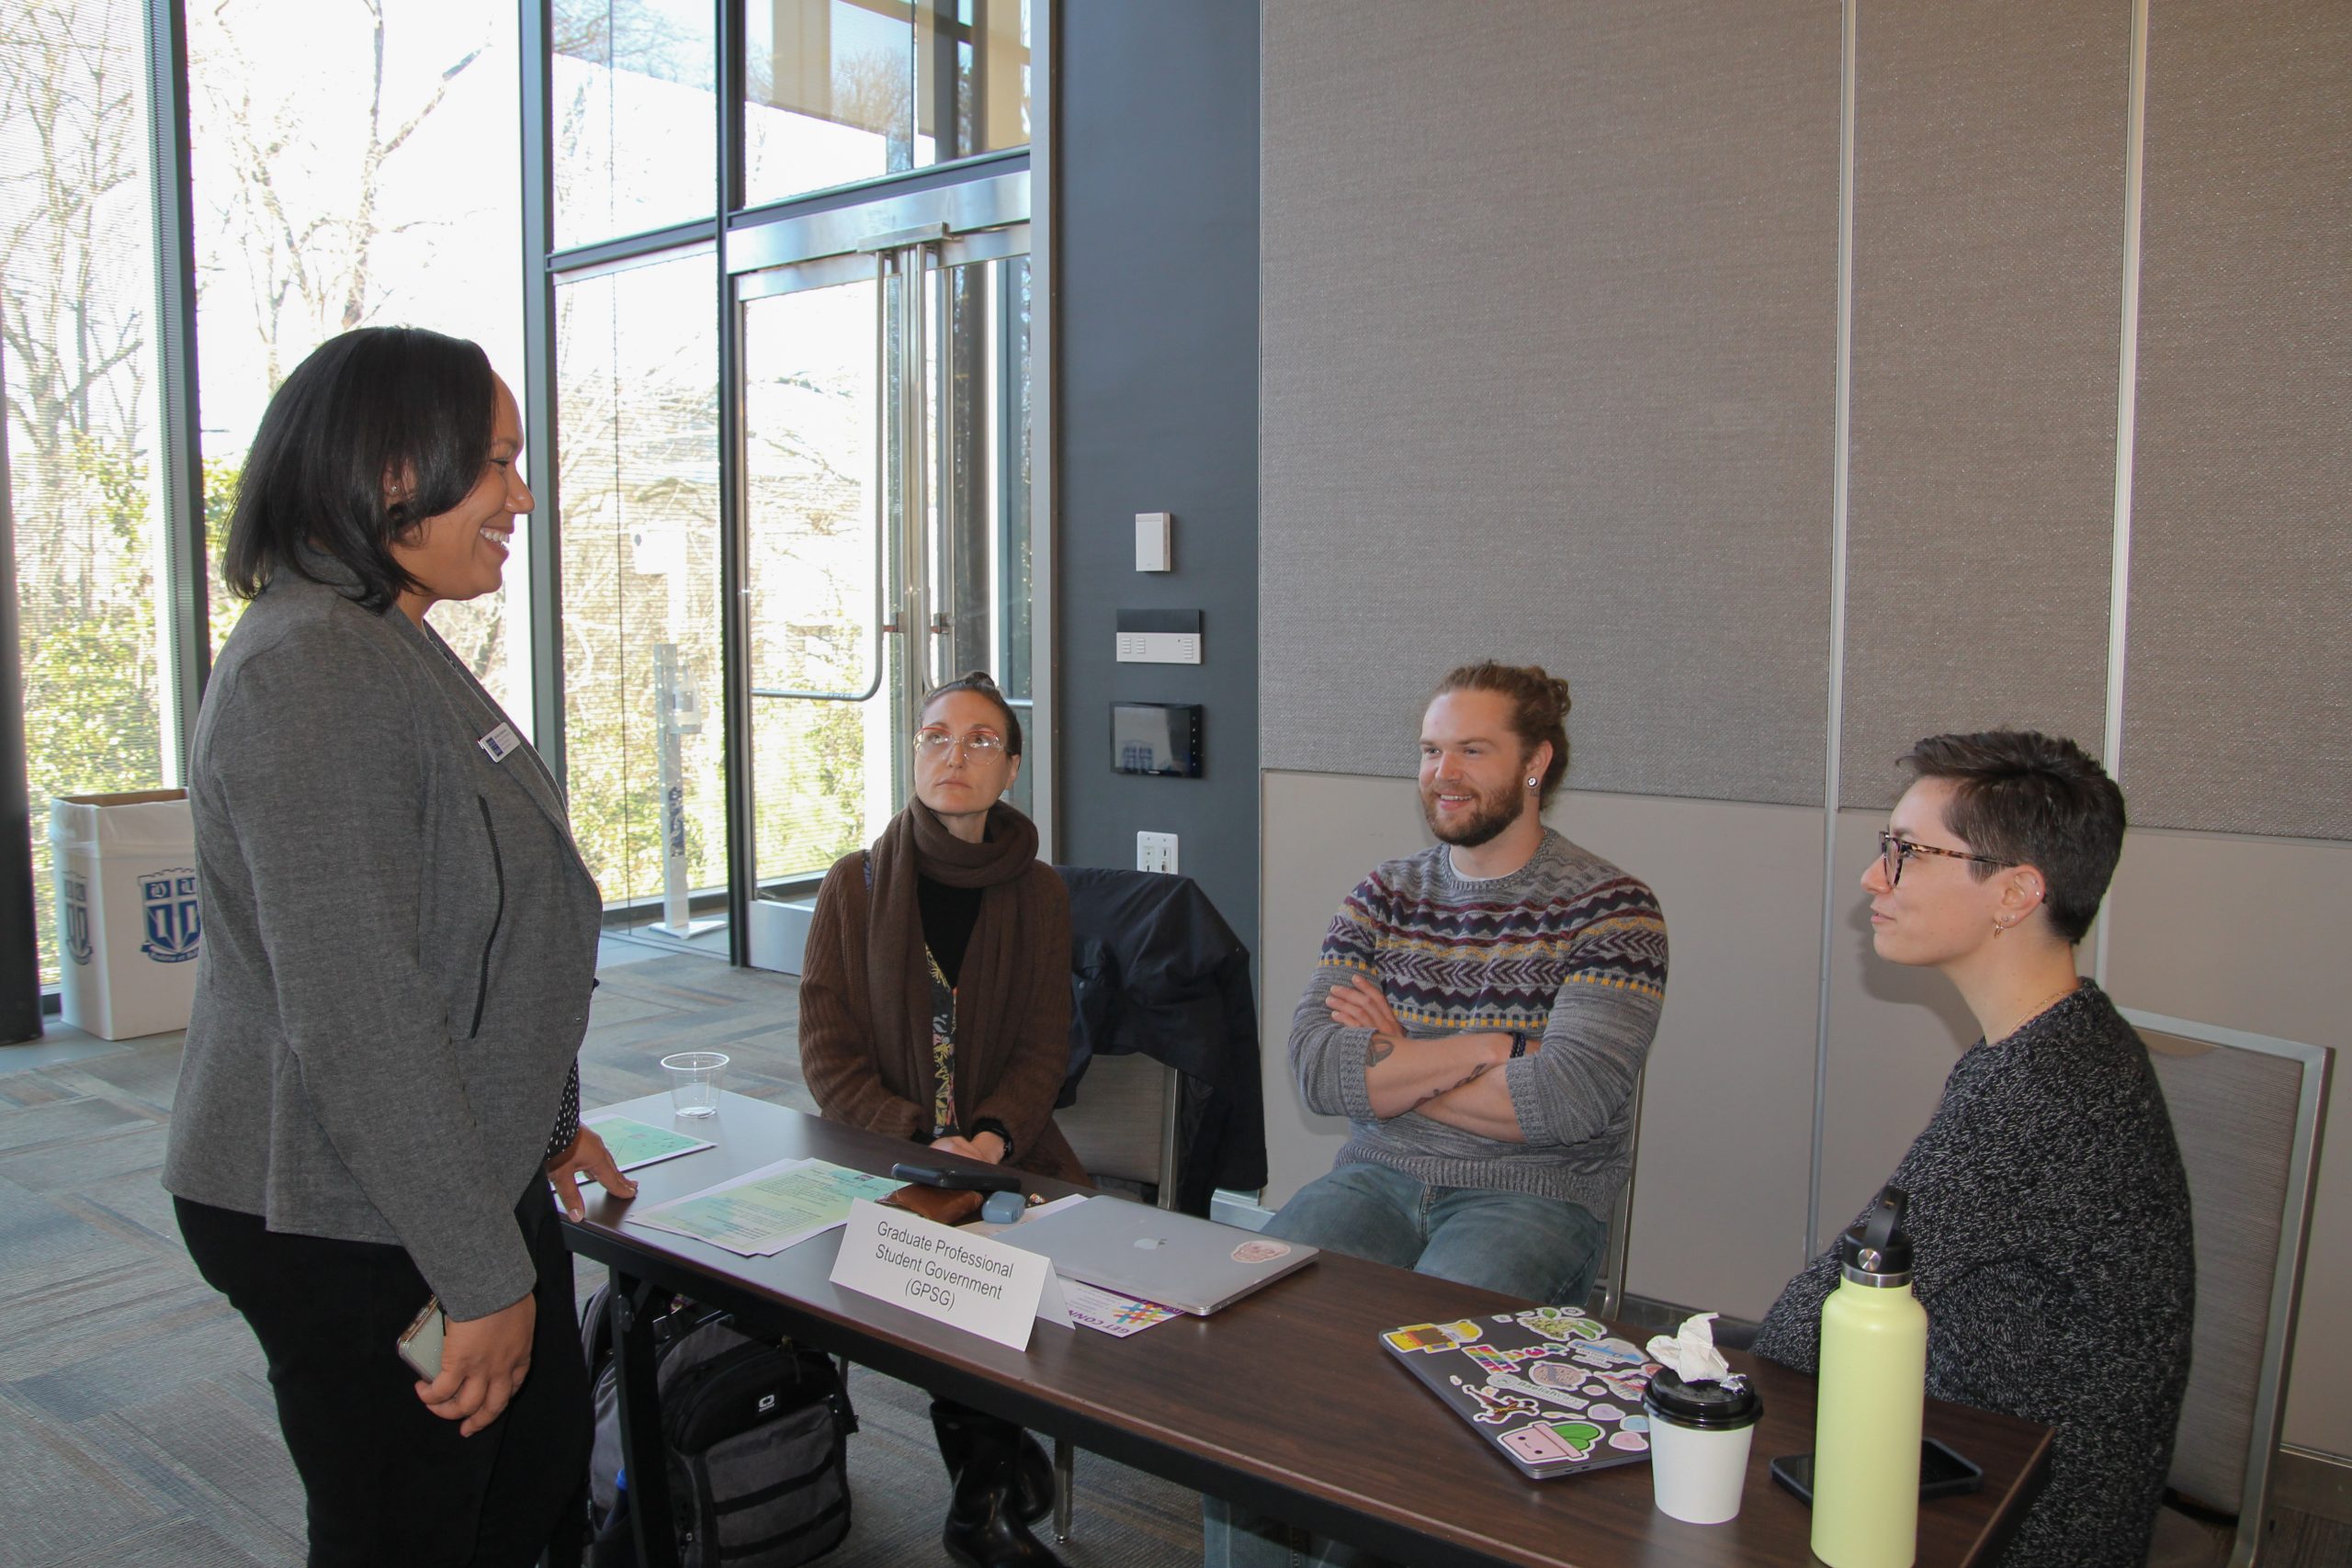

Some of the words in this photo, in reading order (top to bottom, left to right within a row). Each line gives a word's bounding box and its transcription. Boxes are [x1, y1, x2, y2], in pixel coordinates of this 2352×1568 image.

[876, 1244, 922, 1272] Student
[925, 1260, 1002, 1300] Government
[877, 1221, 932, 1251] Graduate
[935, 1239, 1014, 1278] Professional
[905, 1278, 956, 1312] (GPSG)
[1102, 1324, 1130, 1334] GET
